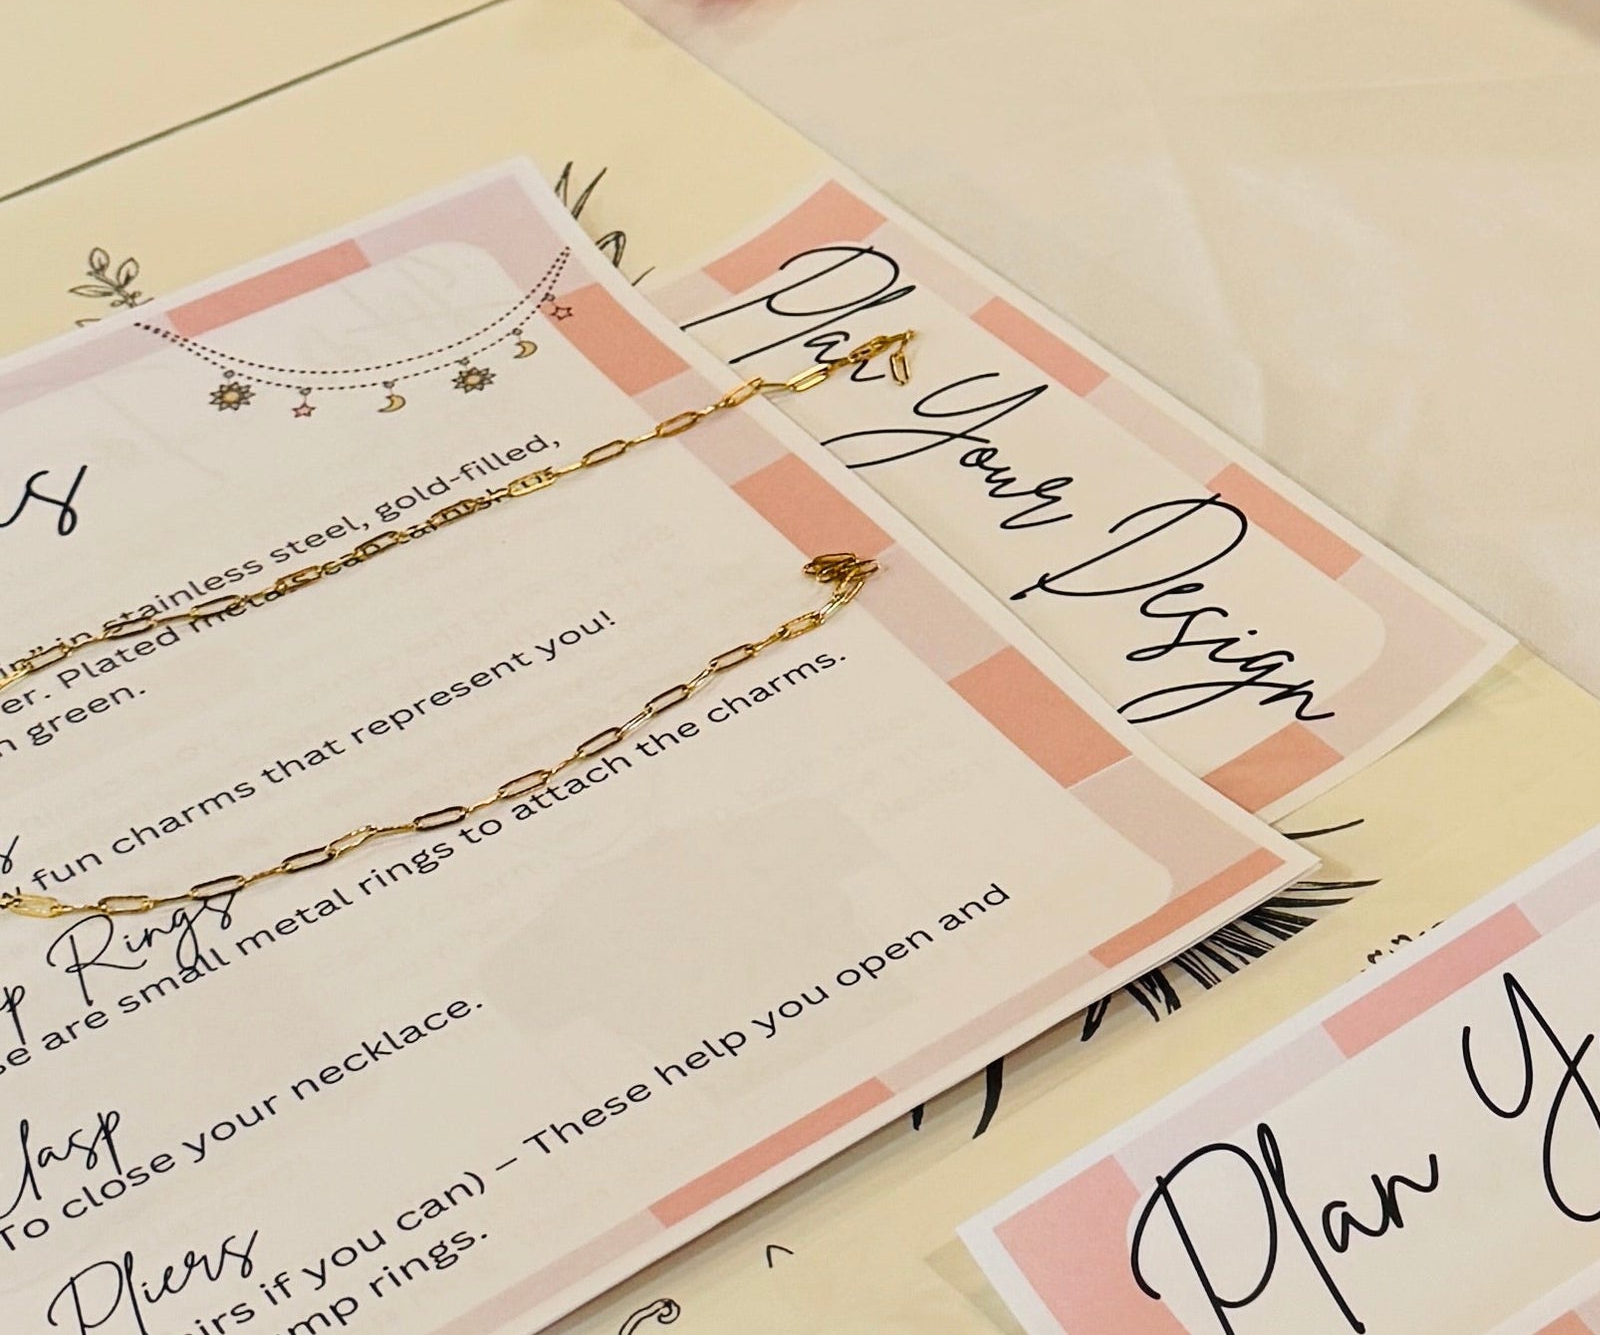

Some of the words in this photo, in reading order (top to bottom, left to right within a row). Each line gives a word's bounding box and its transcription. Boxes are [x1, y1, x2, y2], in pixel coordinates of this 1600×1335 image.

[103, 559, 263, 635] stainless
[270, 516, 369, 563] steel,
[375, 434, 560, 522] gold-filled,
[680, 245, 916, 383] Plan
[820, 372, 1073, 530] Your
[1010, 493, 1336, 724] Design
[27, 685, 146, 746] green.
[57, 625, 180, 689] Plated
[189, 572, 308, 633] metas
[32, 853, 102, 891] fun
[112, 781, 256, 854] charms
[261, 739, 346, 784] that
[352, 651, 532, 742] represent
[535, 611, 616, 661] you!
[41, 1010, 109, 1051] are
[117, 948, 231, 1014] small
[235, 887, 353, 956] metal
[357, 841, 454, 896] rings
[458, 818, 502, 844] to
[511, 752, 632, 822] attach
[635, 721, 700, 758] the
[707, 652, 847, 724] charms.
[46, 893, 236, 1006] Rings
[62, 1152, 176, 1219] close
[182, 1094, 278, 1163] your
[291, 998, 484, 1101] necklace.
[259, 1271, 292, 1306] if
[301, 1229, 386, 1291] you
[396, 1171, 486, 1231] can)
[522, 1083, 652, 1156] These
[653, 1031, 747, 1086] help
[751, 985, 830, 1039] you
[835, 928, 933, 988] open
[938, 883, 1011, 932] and
[47, 1229, 259, 1335] Pliers
[369, 1229, 488, 1299] rings.
[1130, 1122, 1439, 1335] Plan
